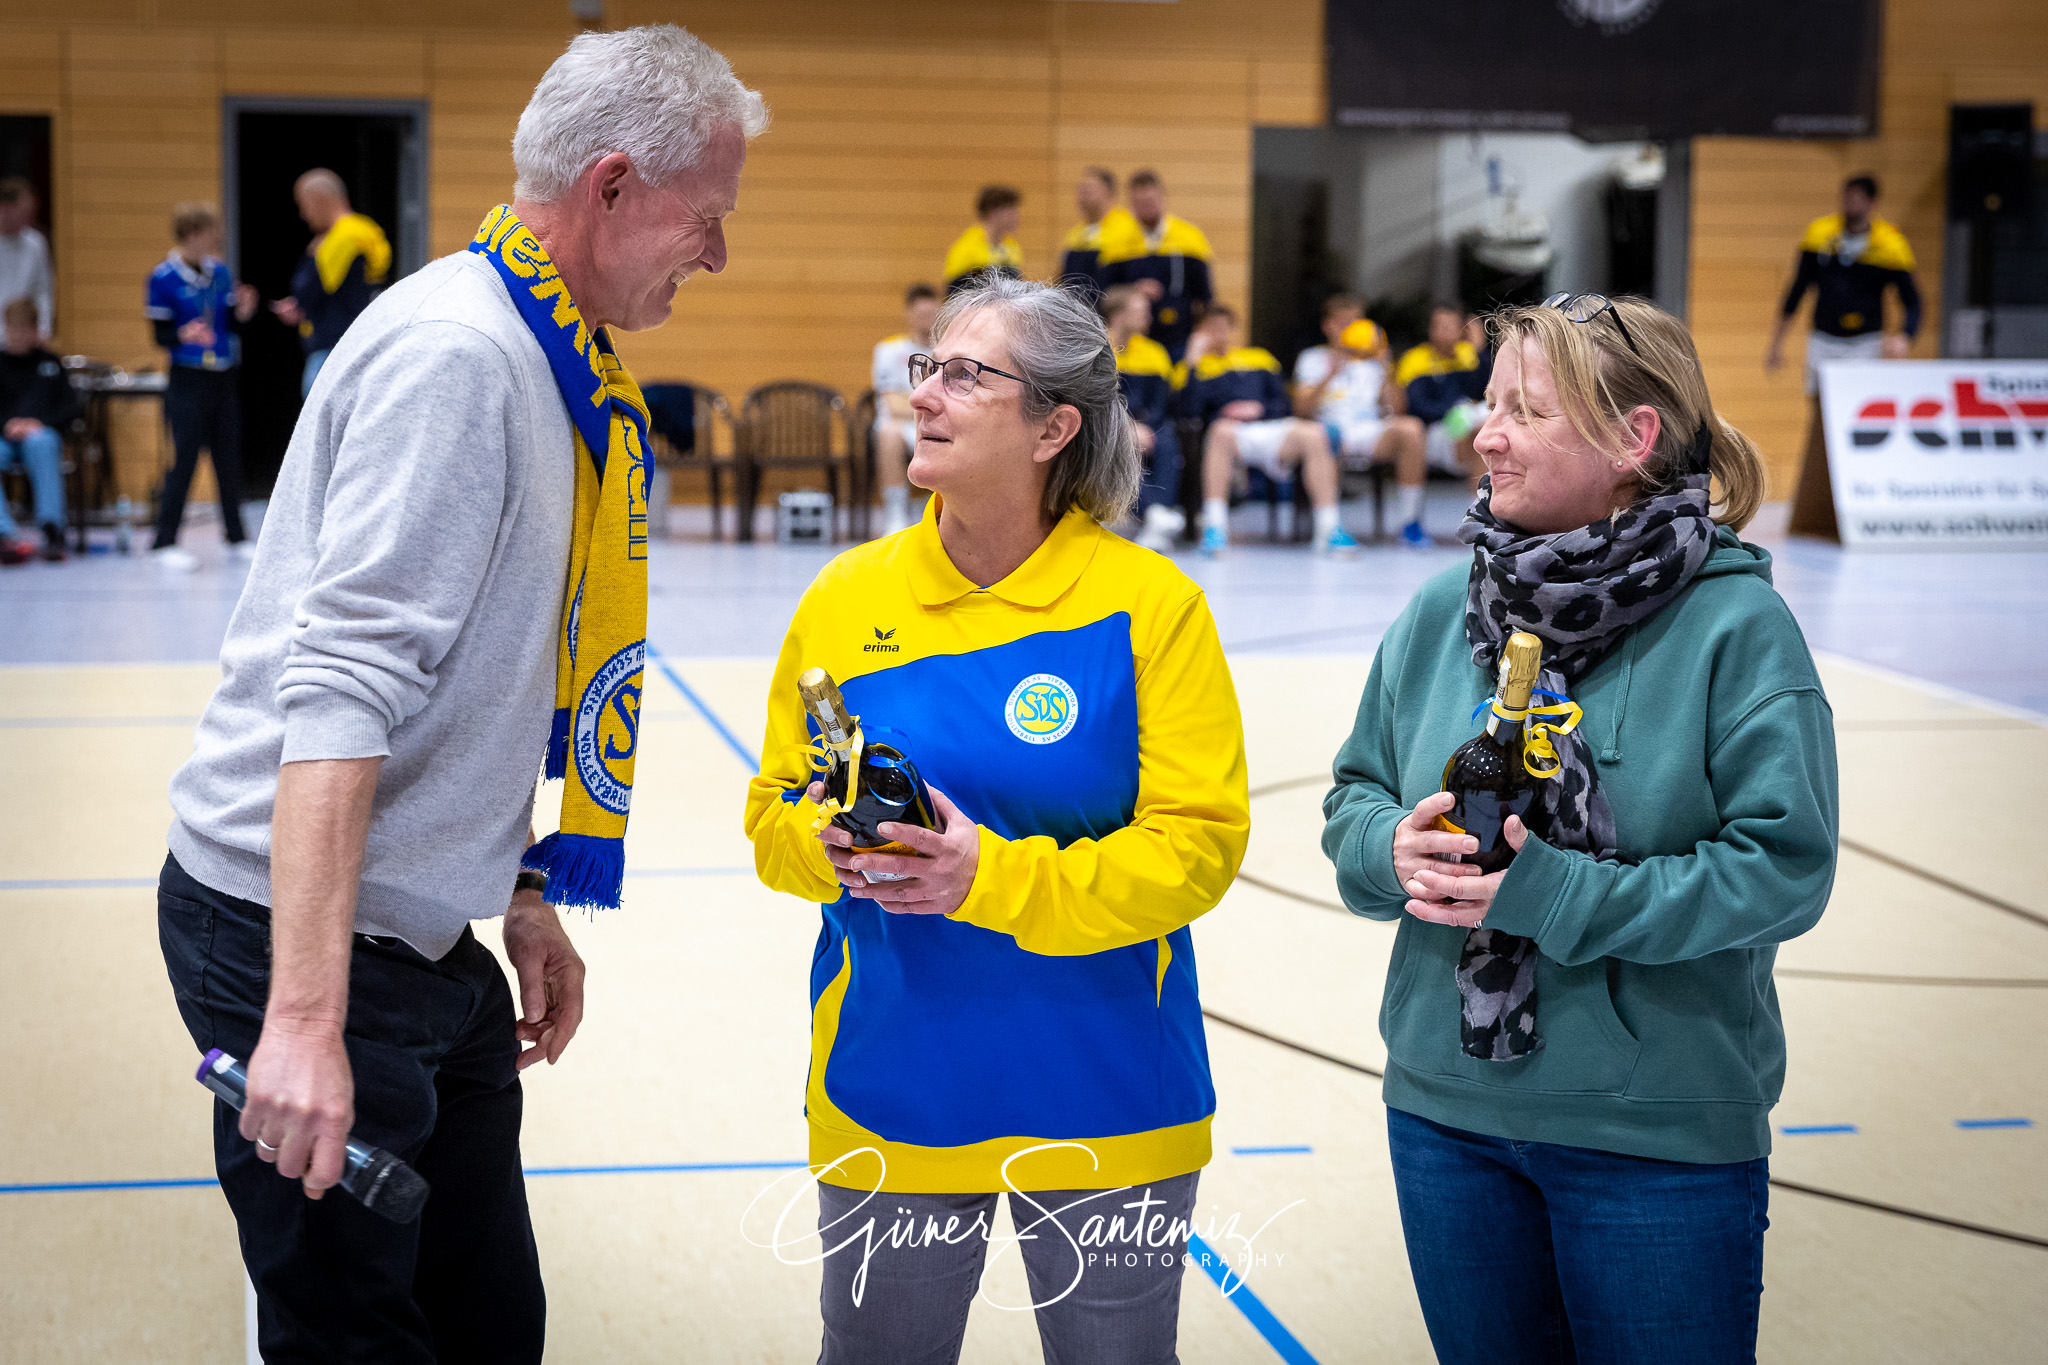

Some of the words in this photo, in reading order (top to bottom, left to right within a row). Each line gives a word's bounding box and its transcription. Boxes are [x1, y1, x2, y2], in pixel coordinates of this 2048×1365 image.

[863, 641, 900, 653] erima
[1008, 679, 1031, 706] SCHWAIG
[1047, 676, 1076, 708] VOLLEYBALL
[1007, 713, 1036, 742] VOLLEYBALL
[1053, 713, 1076, 740] SCHWAIG
